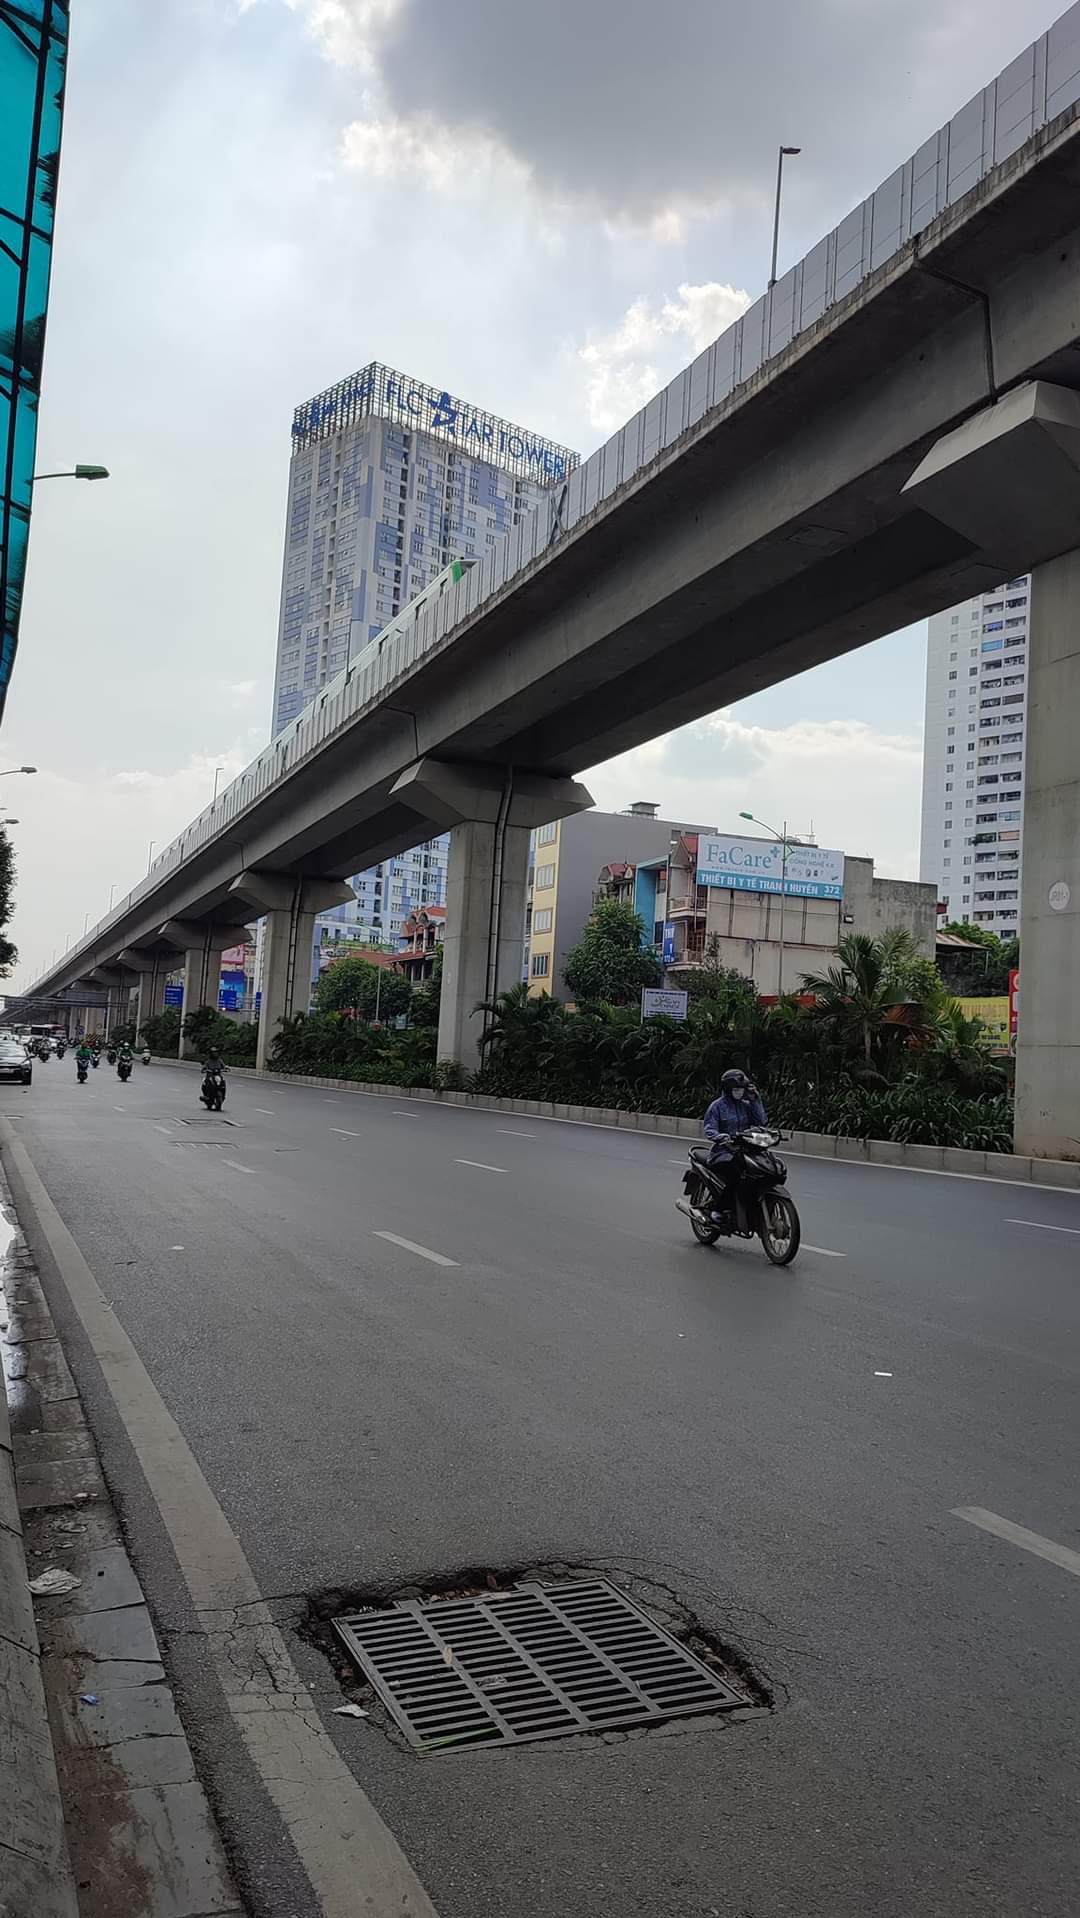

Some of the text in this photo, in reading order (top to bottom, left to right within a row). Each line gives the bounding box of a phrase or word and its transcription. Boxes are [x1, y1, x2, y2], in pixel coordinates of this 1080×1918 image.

[386, 379, 422, 415] FLC
[499, 431, 566, 480] TOWER
[705, 843, 772, 869] FaCare
[700, 872, 725, 884] THIẾT
[727, 876, 737, 887] BỊ
[738, 877, 745, 887] Y
[747, 876, 757, 888] TẾ
[823, 885, 841, 894] 372
